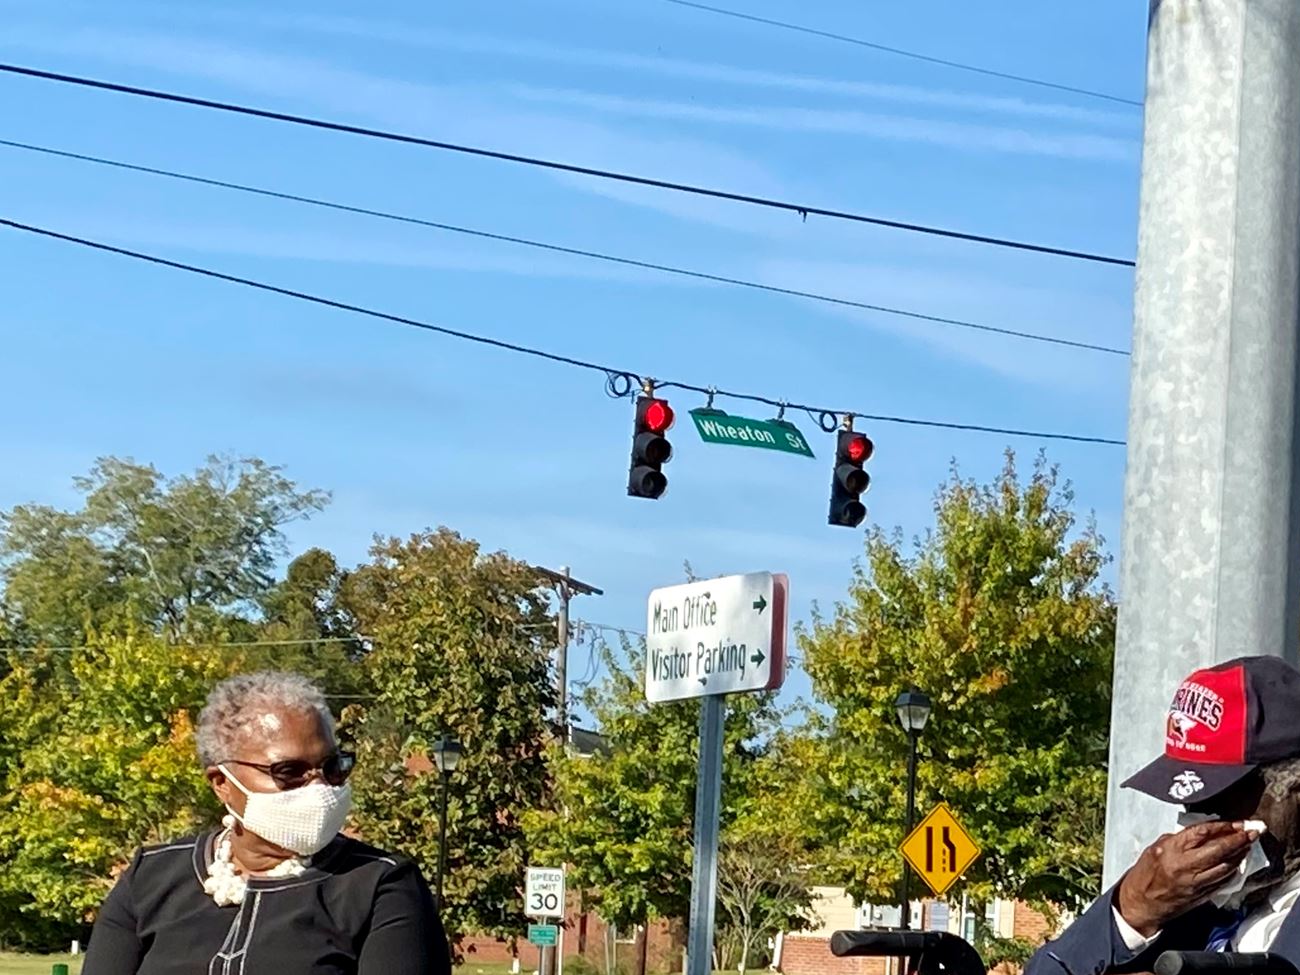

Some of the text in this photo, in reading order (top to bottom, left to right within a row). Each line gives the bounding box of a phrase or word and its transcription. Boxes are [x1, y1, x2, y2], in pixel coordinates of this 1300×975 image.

[699, 419, 807, 451] Wheaton St
[653, 596, 717, 634] Main Office
[651, 638, 746, 682] Visitor Parking
[1171, 687, 1224, 731] RINES
[530, 873, 561, 881] SPEED
[530, 893, 558, 910] 30
